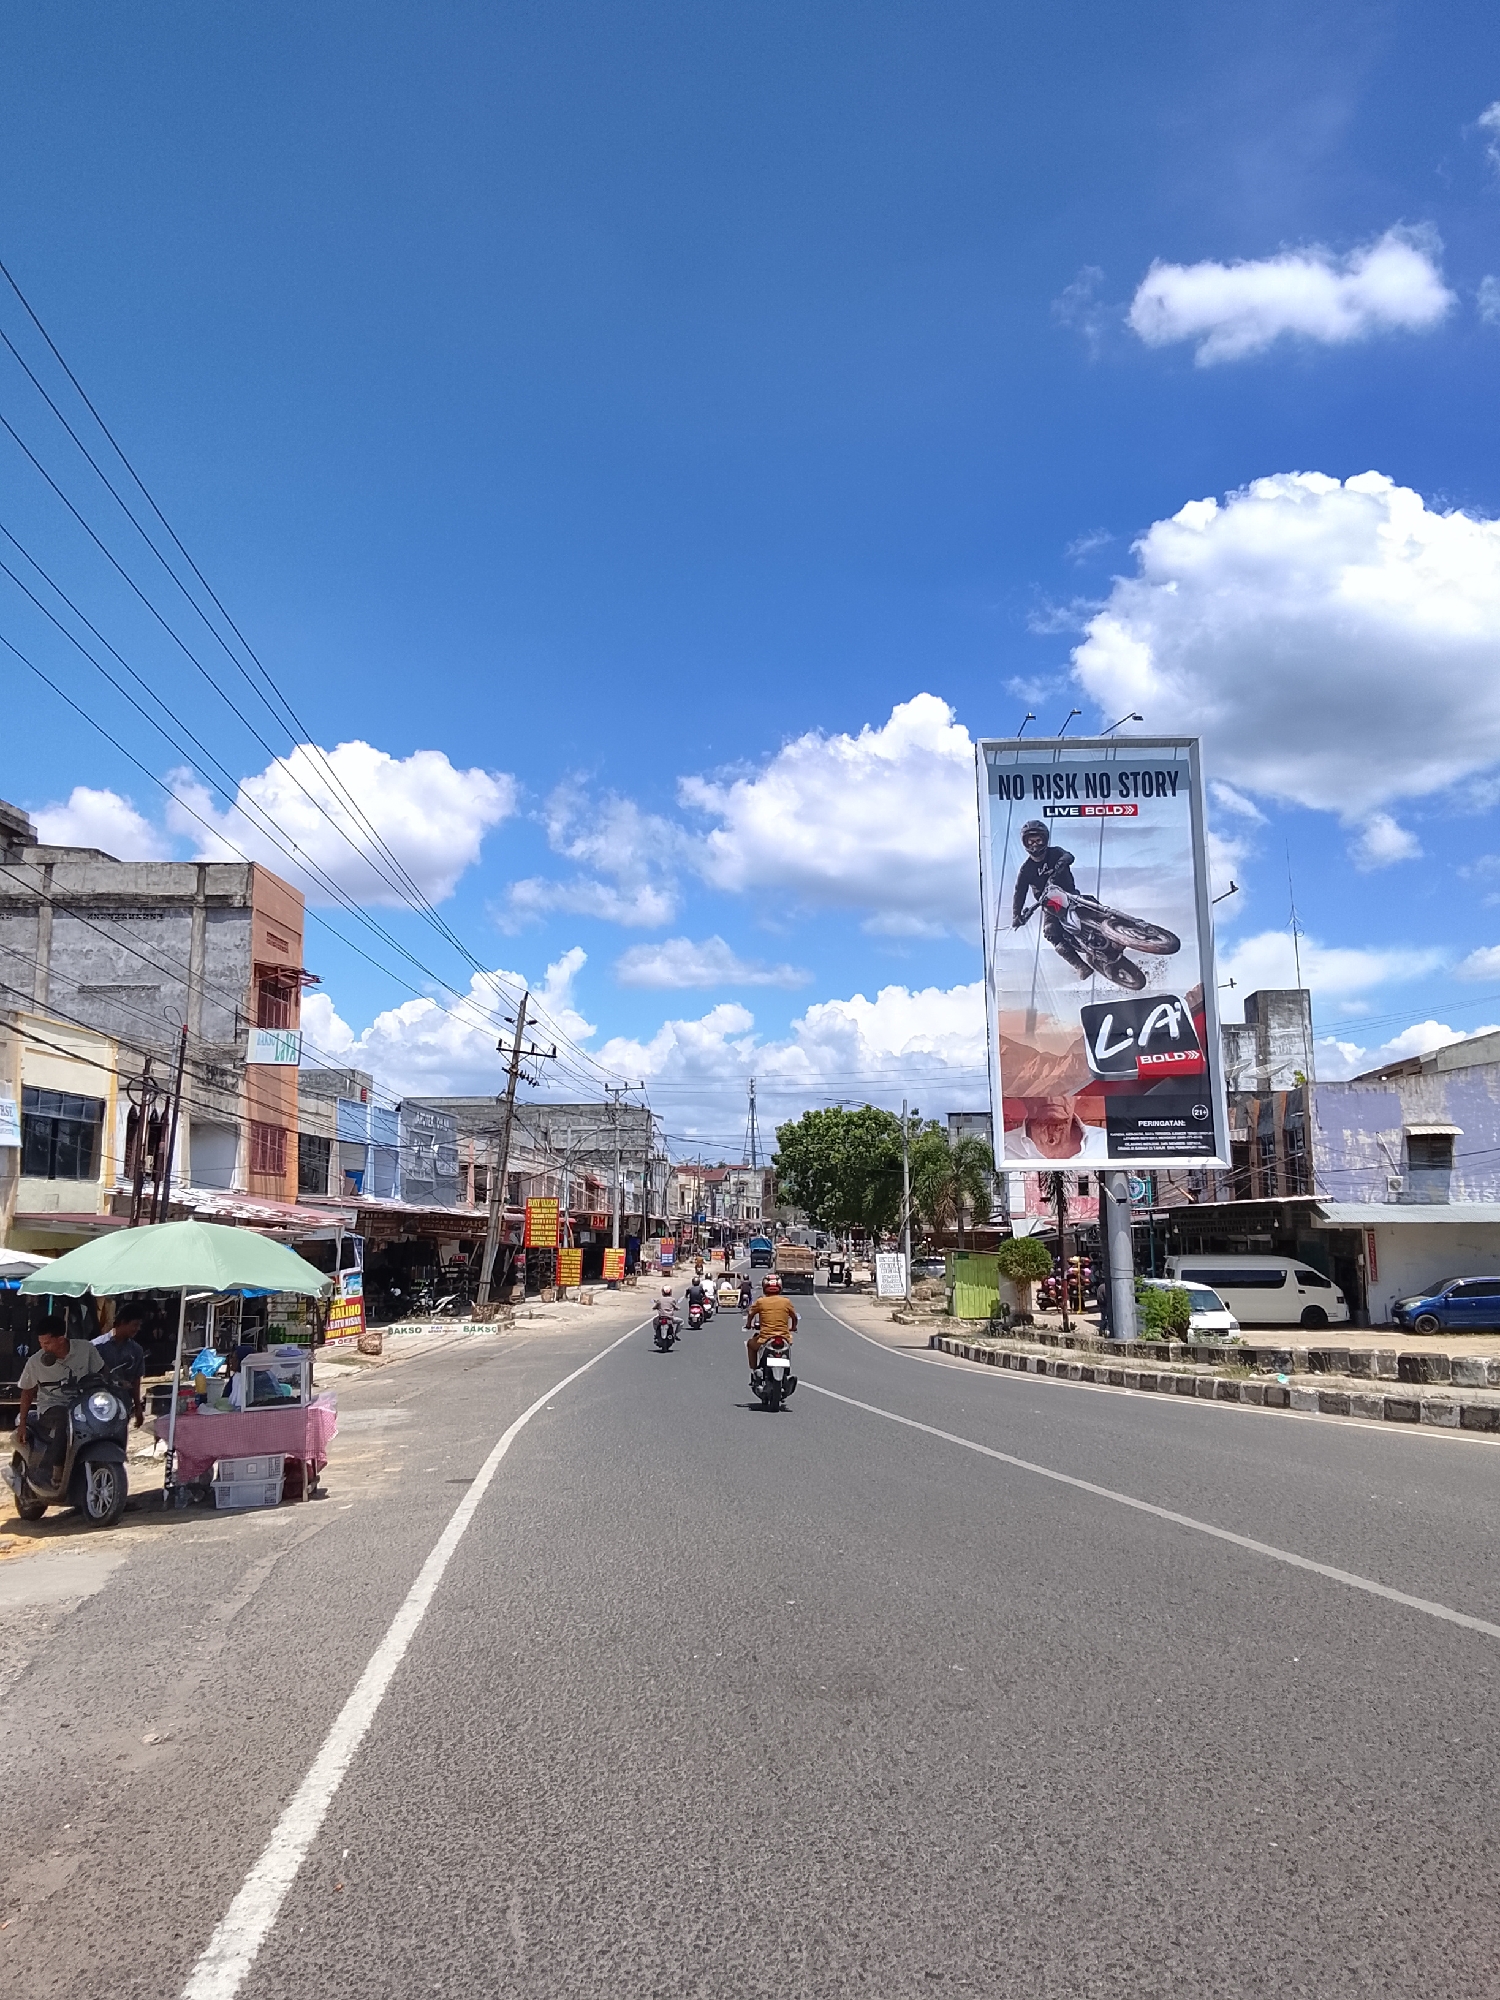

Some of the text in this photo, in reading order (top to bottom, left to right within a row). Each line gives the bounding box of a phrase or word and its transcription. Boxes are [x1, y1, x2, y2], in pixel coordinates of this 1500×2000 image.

[998, 770, 1179, 801] NO RISK NO STORY
[1046, 805, 1123, 817] LIVE BOLD
[1139, 1051, 1186, 1065] BOLD
[592, 1215, 606, 1226] BM
[329, 1304, 361, 1320] BALIHO
[387, 1326, 423, 1336] BAKSO
